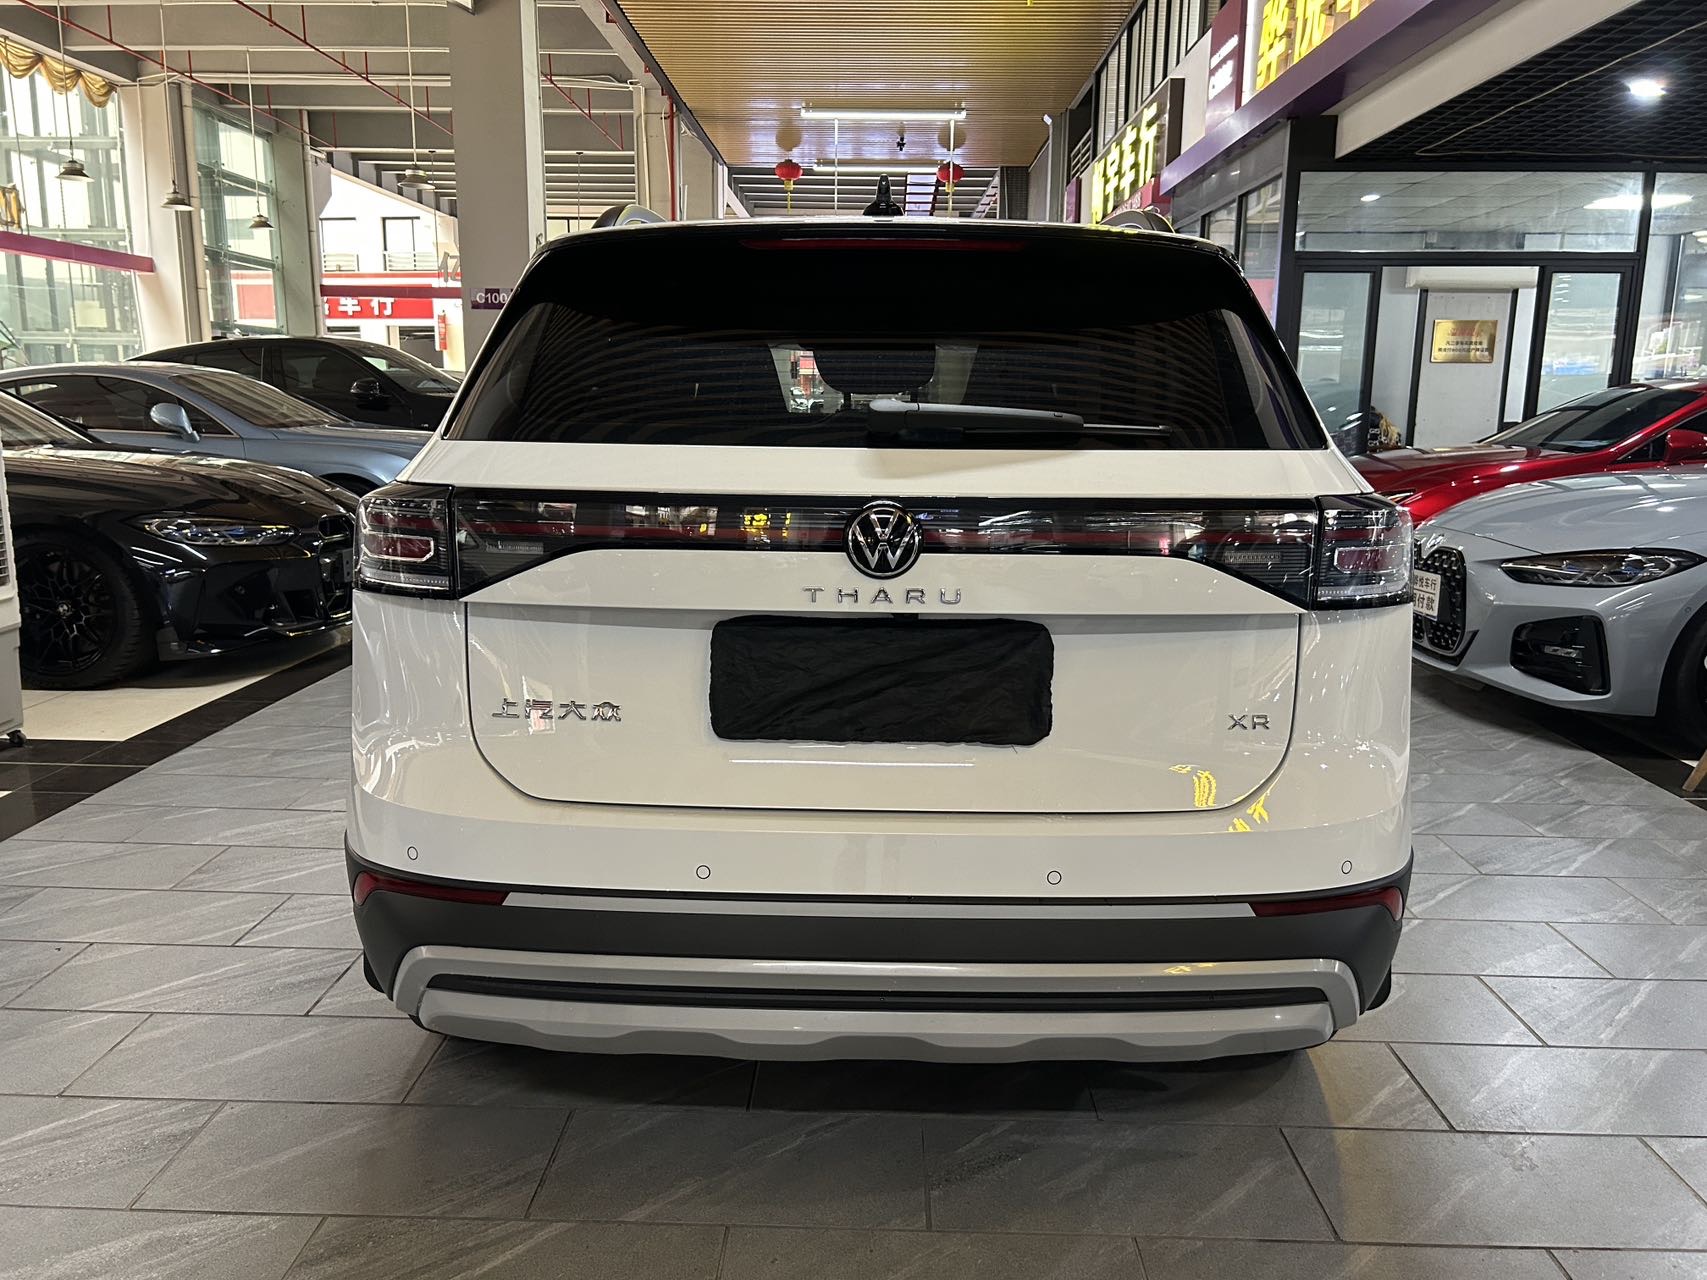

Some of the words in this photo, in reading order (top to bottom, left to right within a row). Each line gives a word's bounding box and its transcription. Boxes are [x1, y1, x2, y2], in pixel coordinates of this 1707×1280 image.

[803, 587, 962, 605] THARU
[491, 698, 622, 722] 上汽大众
[1228, 713, 1270, 731] XR
